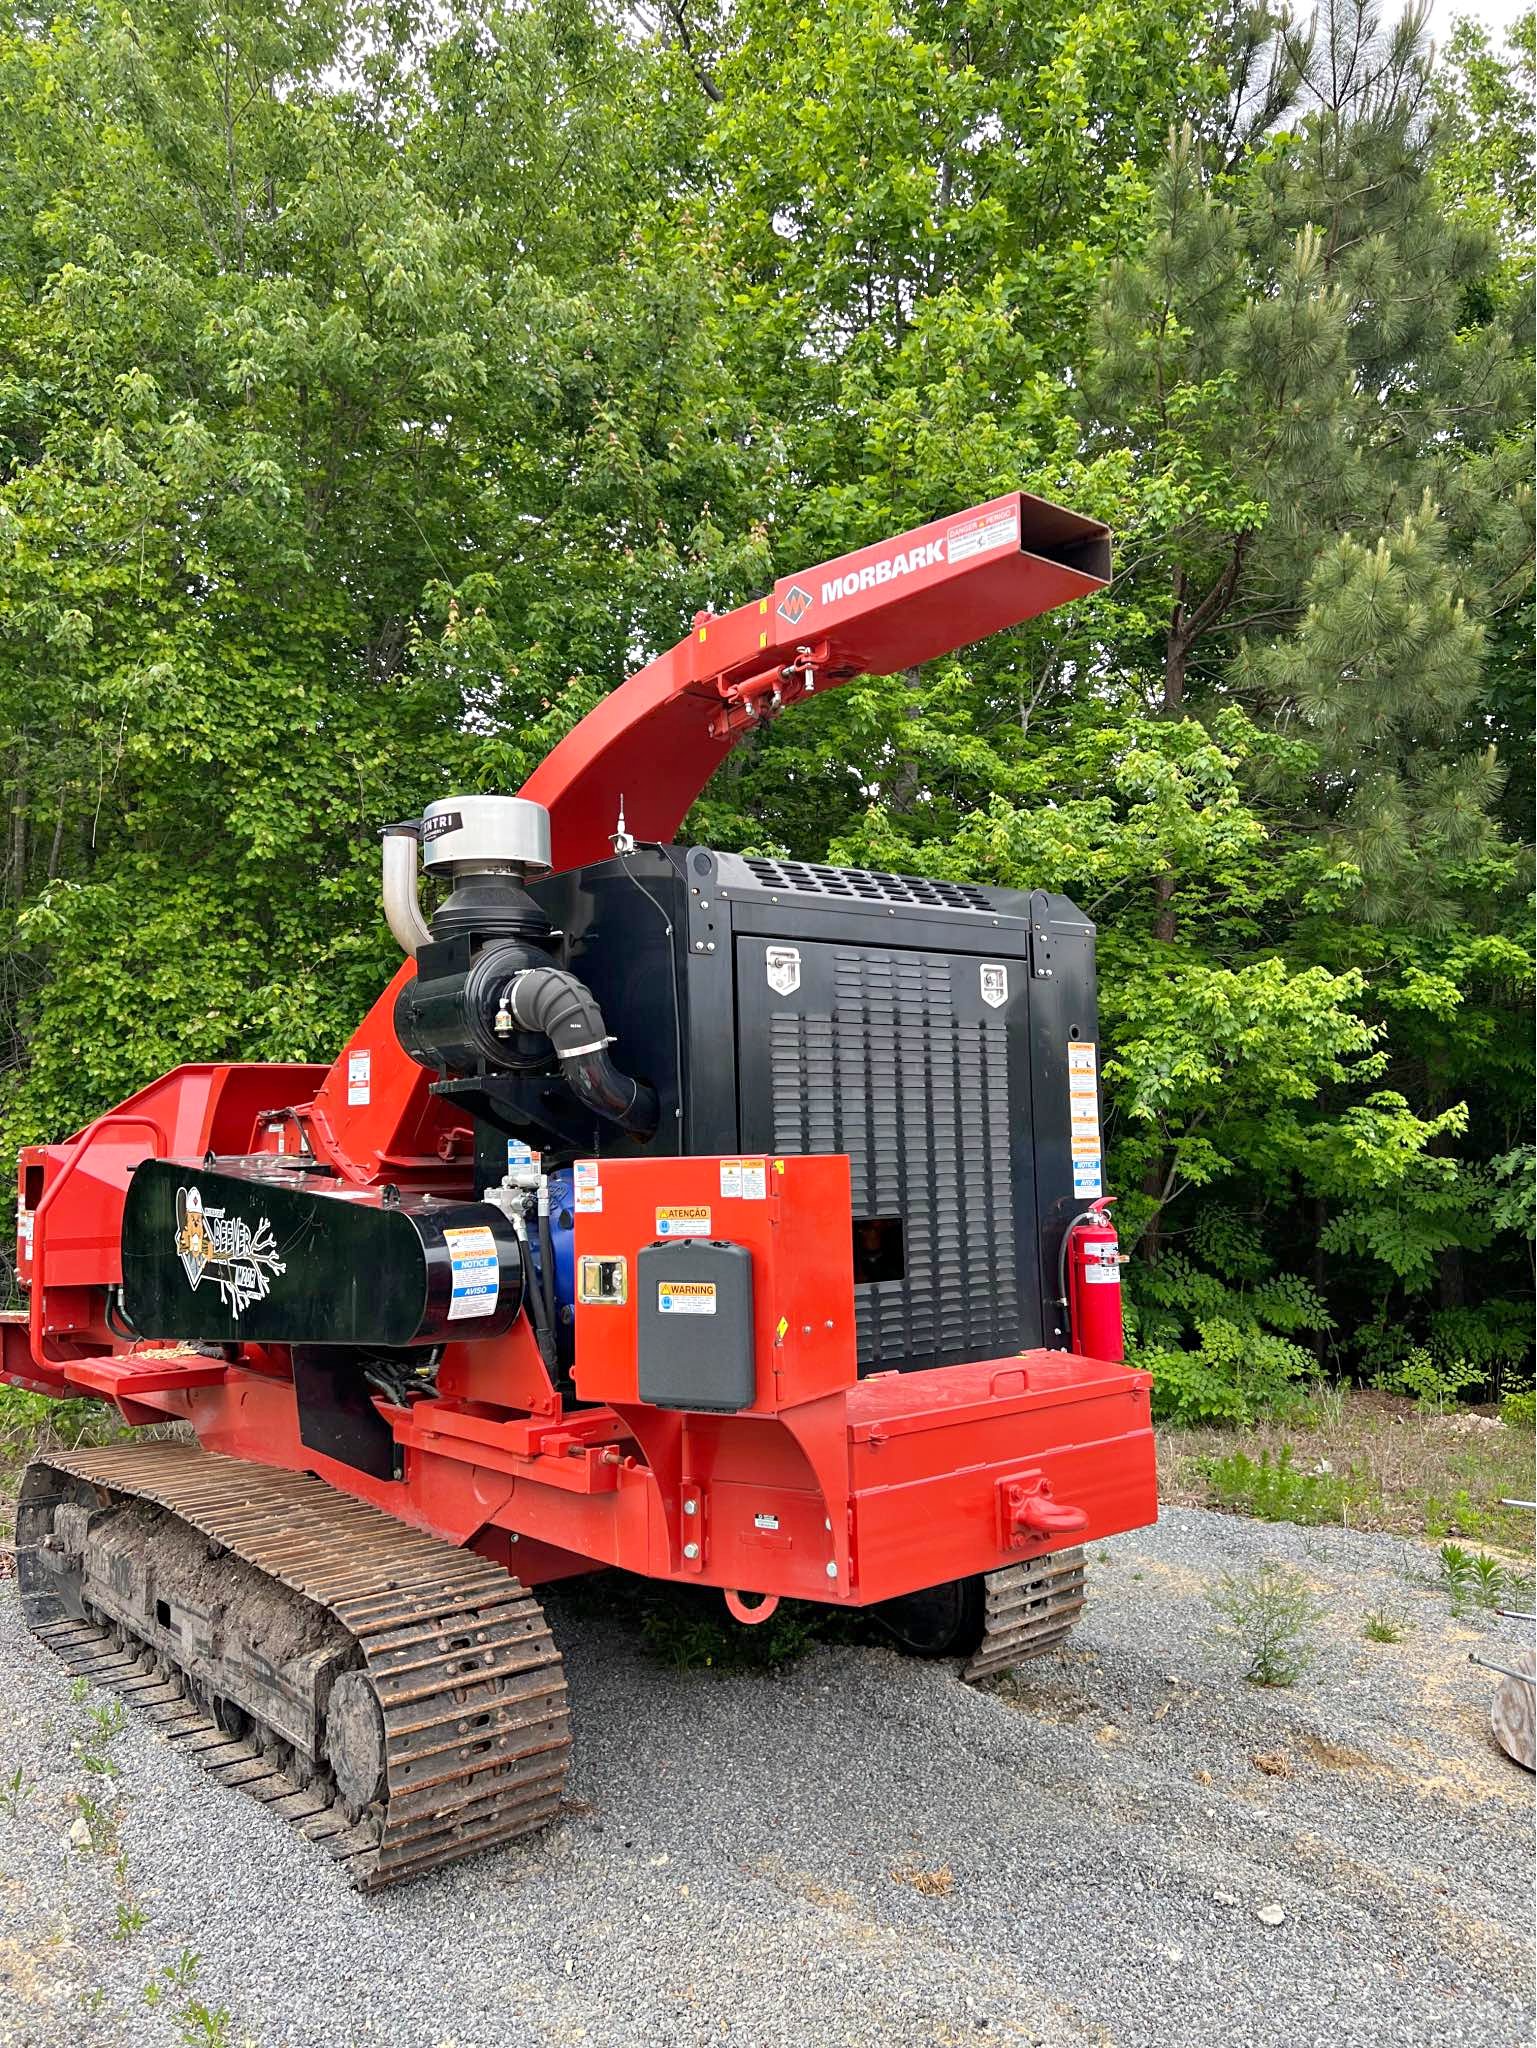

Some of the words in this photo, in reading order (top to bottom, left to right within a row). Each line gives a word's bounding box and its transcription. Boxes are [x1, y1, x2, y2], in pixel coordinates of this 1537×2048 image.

[821, 538, 945, 606] MORBARK
[668, 1207, 707, 1218] ATENÇÃO
[460, 1258, 489, 1269] NOTICE
[464, 1286, 487, 1296] AVISO
[670, 1285, 714, 1295] WARNING
